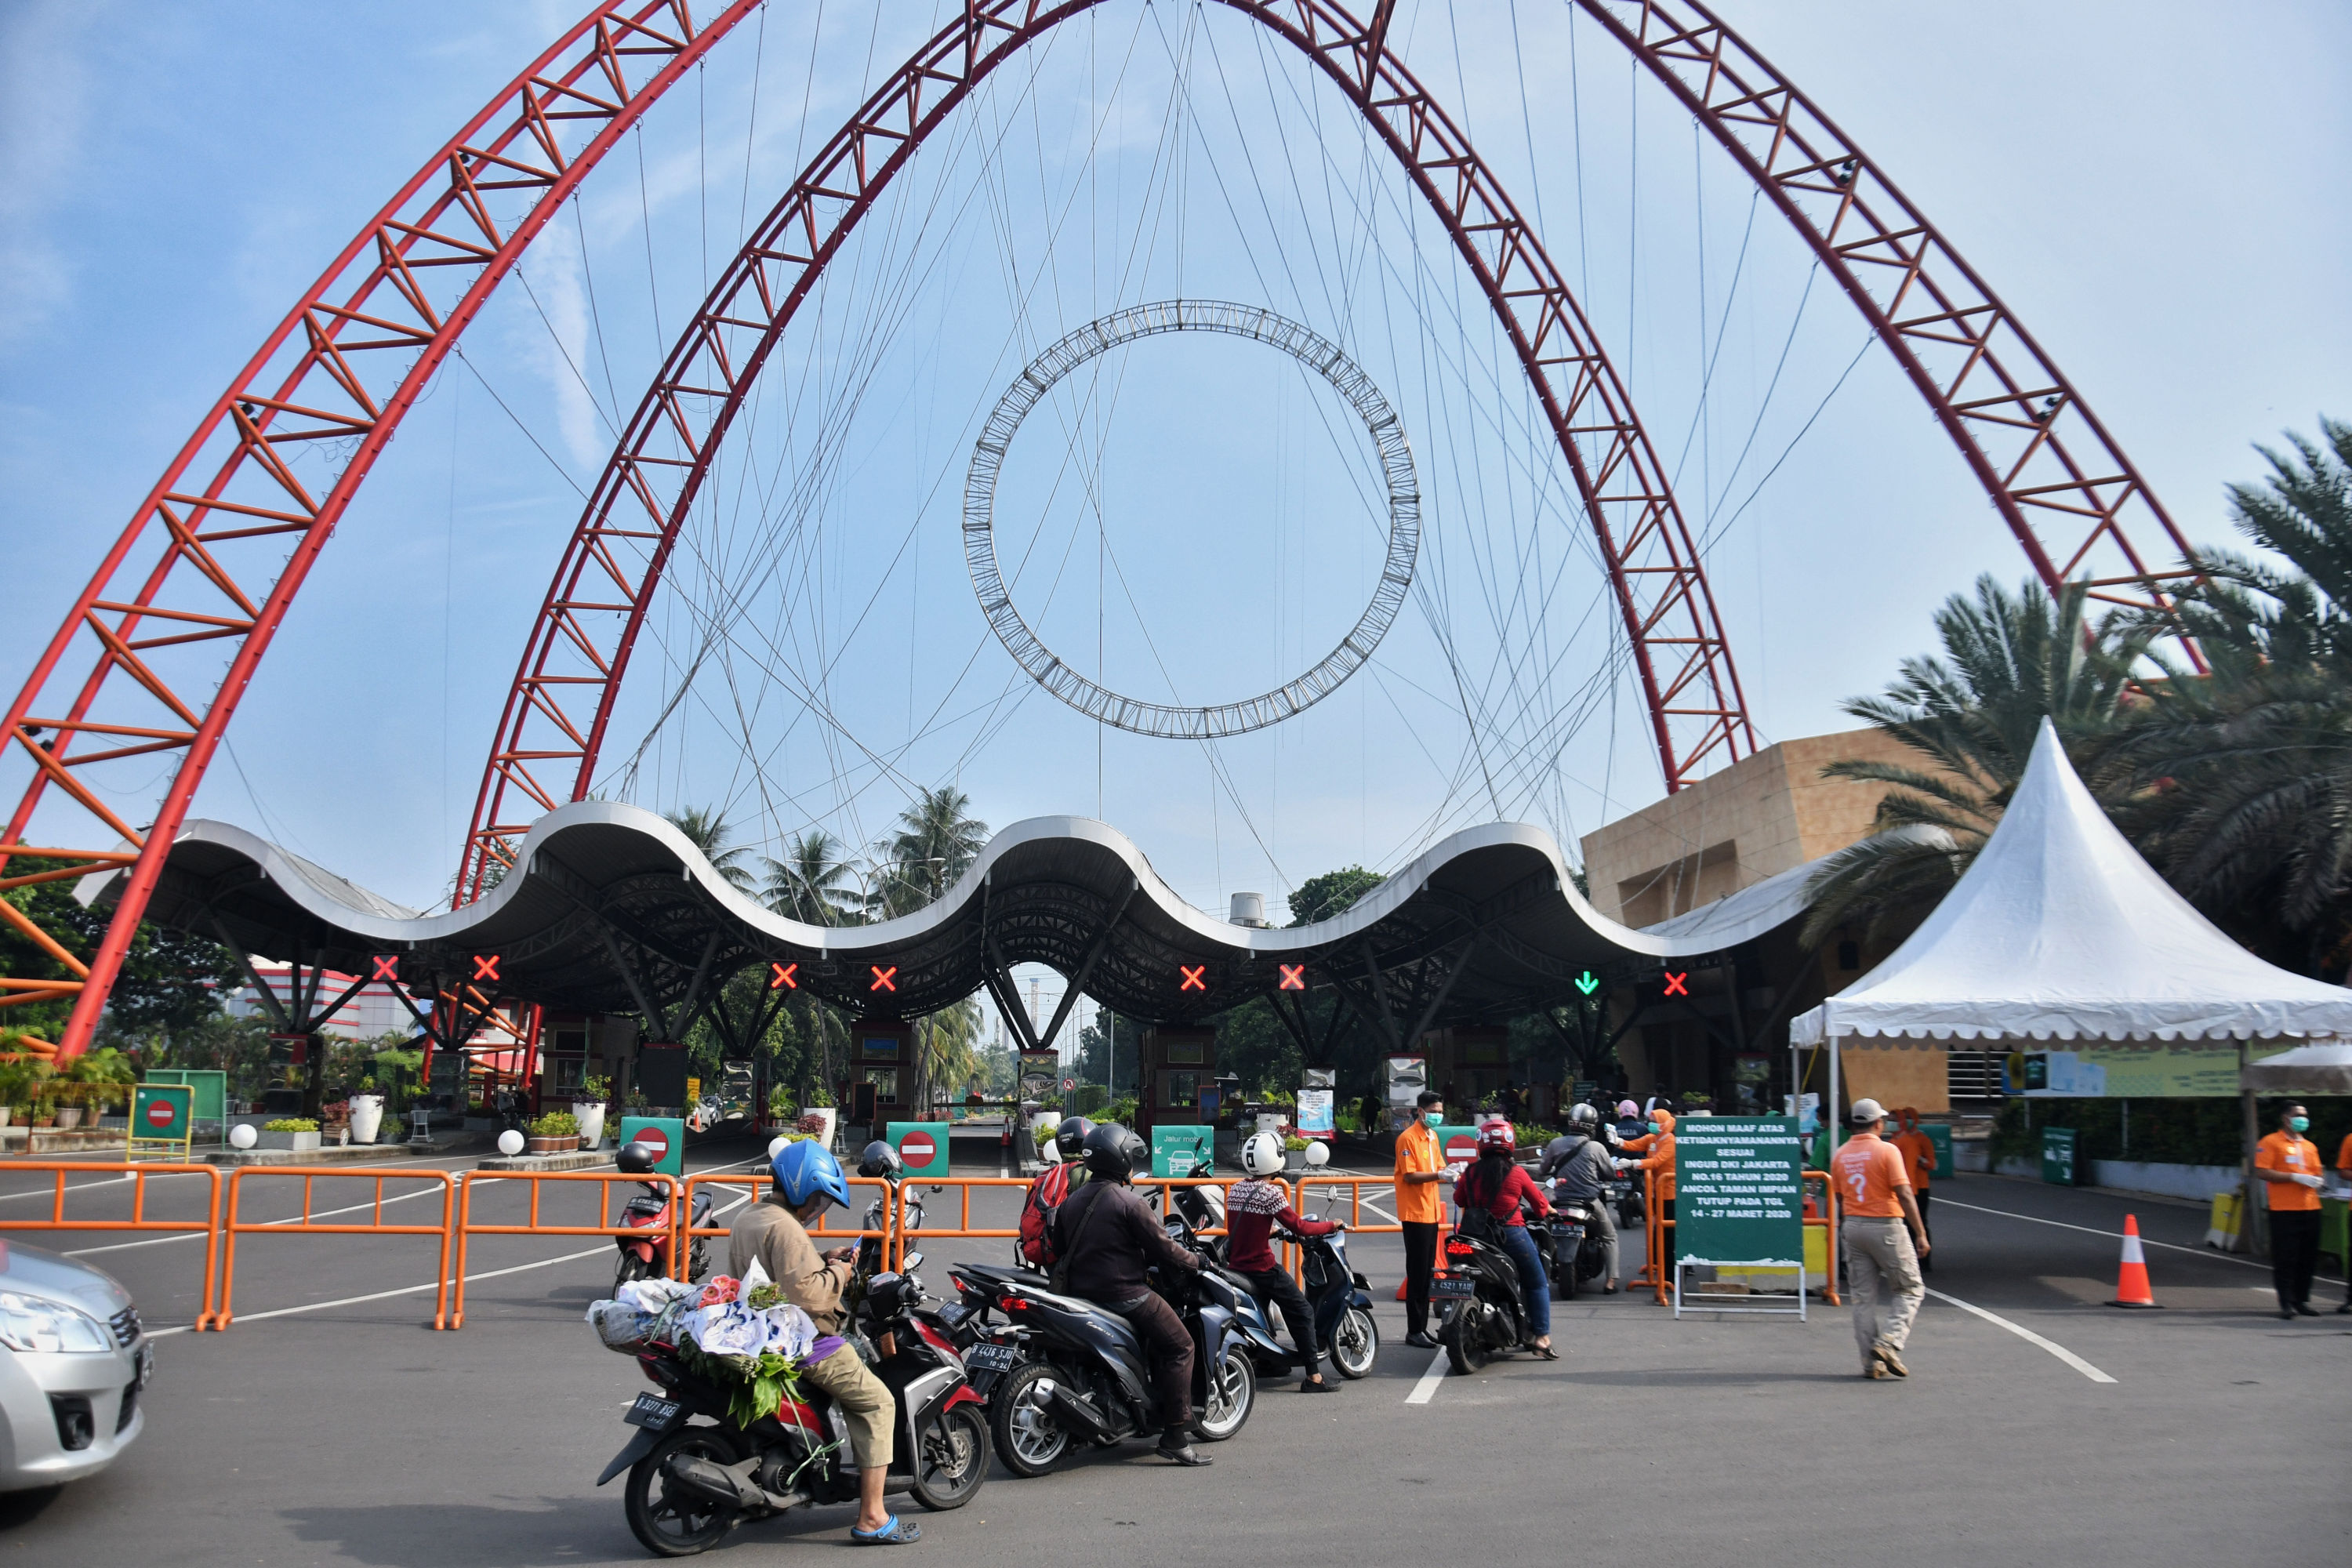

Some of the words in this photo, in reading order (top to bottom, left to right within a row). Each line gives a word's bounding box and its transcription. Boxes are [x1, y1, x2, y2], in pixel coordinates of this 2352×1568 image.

[1686, 1124, 1725, 1133] MOHON
[1726, 1124, 1757, 1133] MAAF
[1758, 1124, 1786, 1133] ATAS
[1676, 1136, 1800, 1145] KETIDAKNYAMANANNYA
[1716, 1149, 1755, 1157] SESUAI
[1685, 1160, 1719, 1169] INGUB
[1720, 1160, 1740, 1169] DKI
[1741, 1160, 1791, 1169] JAKARTA
[1725, 1173, 1762, 1181] TAHUN
[1762, 1173, 1789, 1181] 2020
[1681, 1185, 1718, 1193] ANCOL
[1719, 1185, 1757, 1193] TAMAN
[1758, 1185, 1797, 1193] IMPIAN
[1696, 1196, 1732, 1206] TUTUP
[1733, 1197, 1762, 1206] PADA
[1763, 1197, 1785, 1206] TGL
[1690, 1209, 1703, 1218] 14
[1711, 1209, 1724, 1218] 27
[1726, 1209, 1764, 1218] MARET
[1765, 1209, 1791, 1218] 2020
[999, 1349, 1014, 1359] SJU
